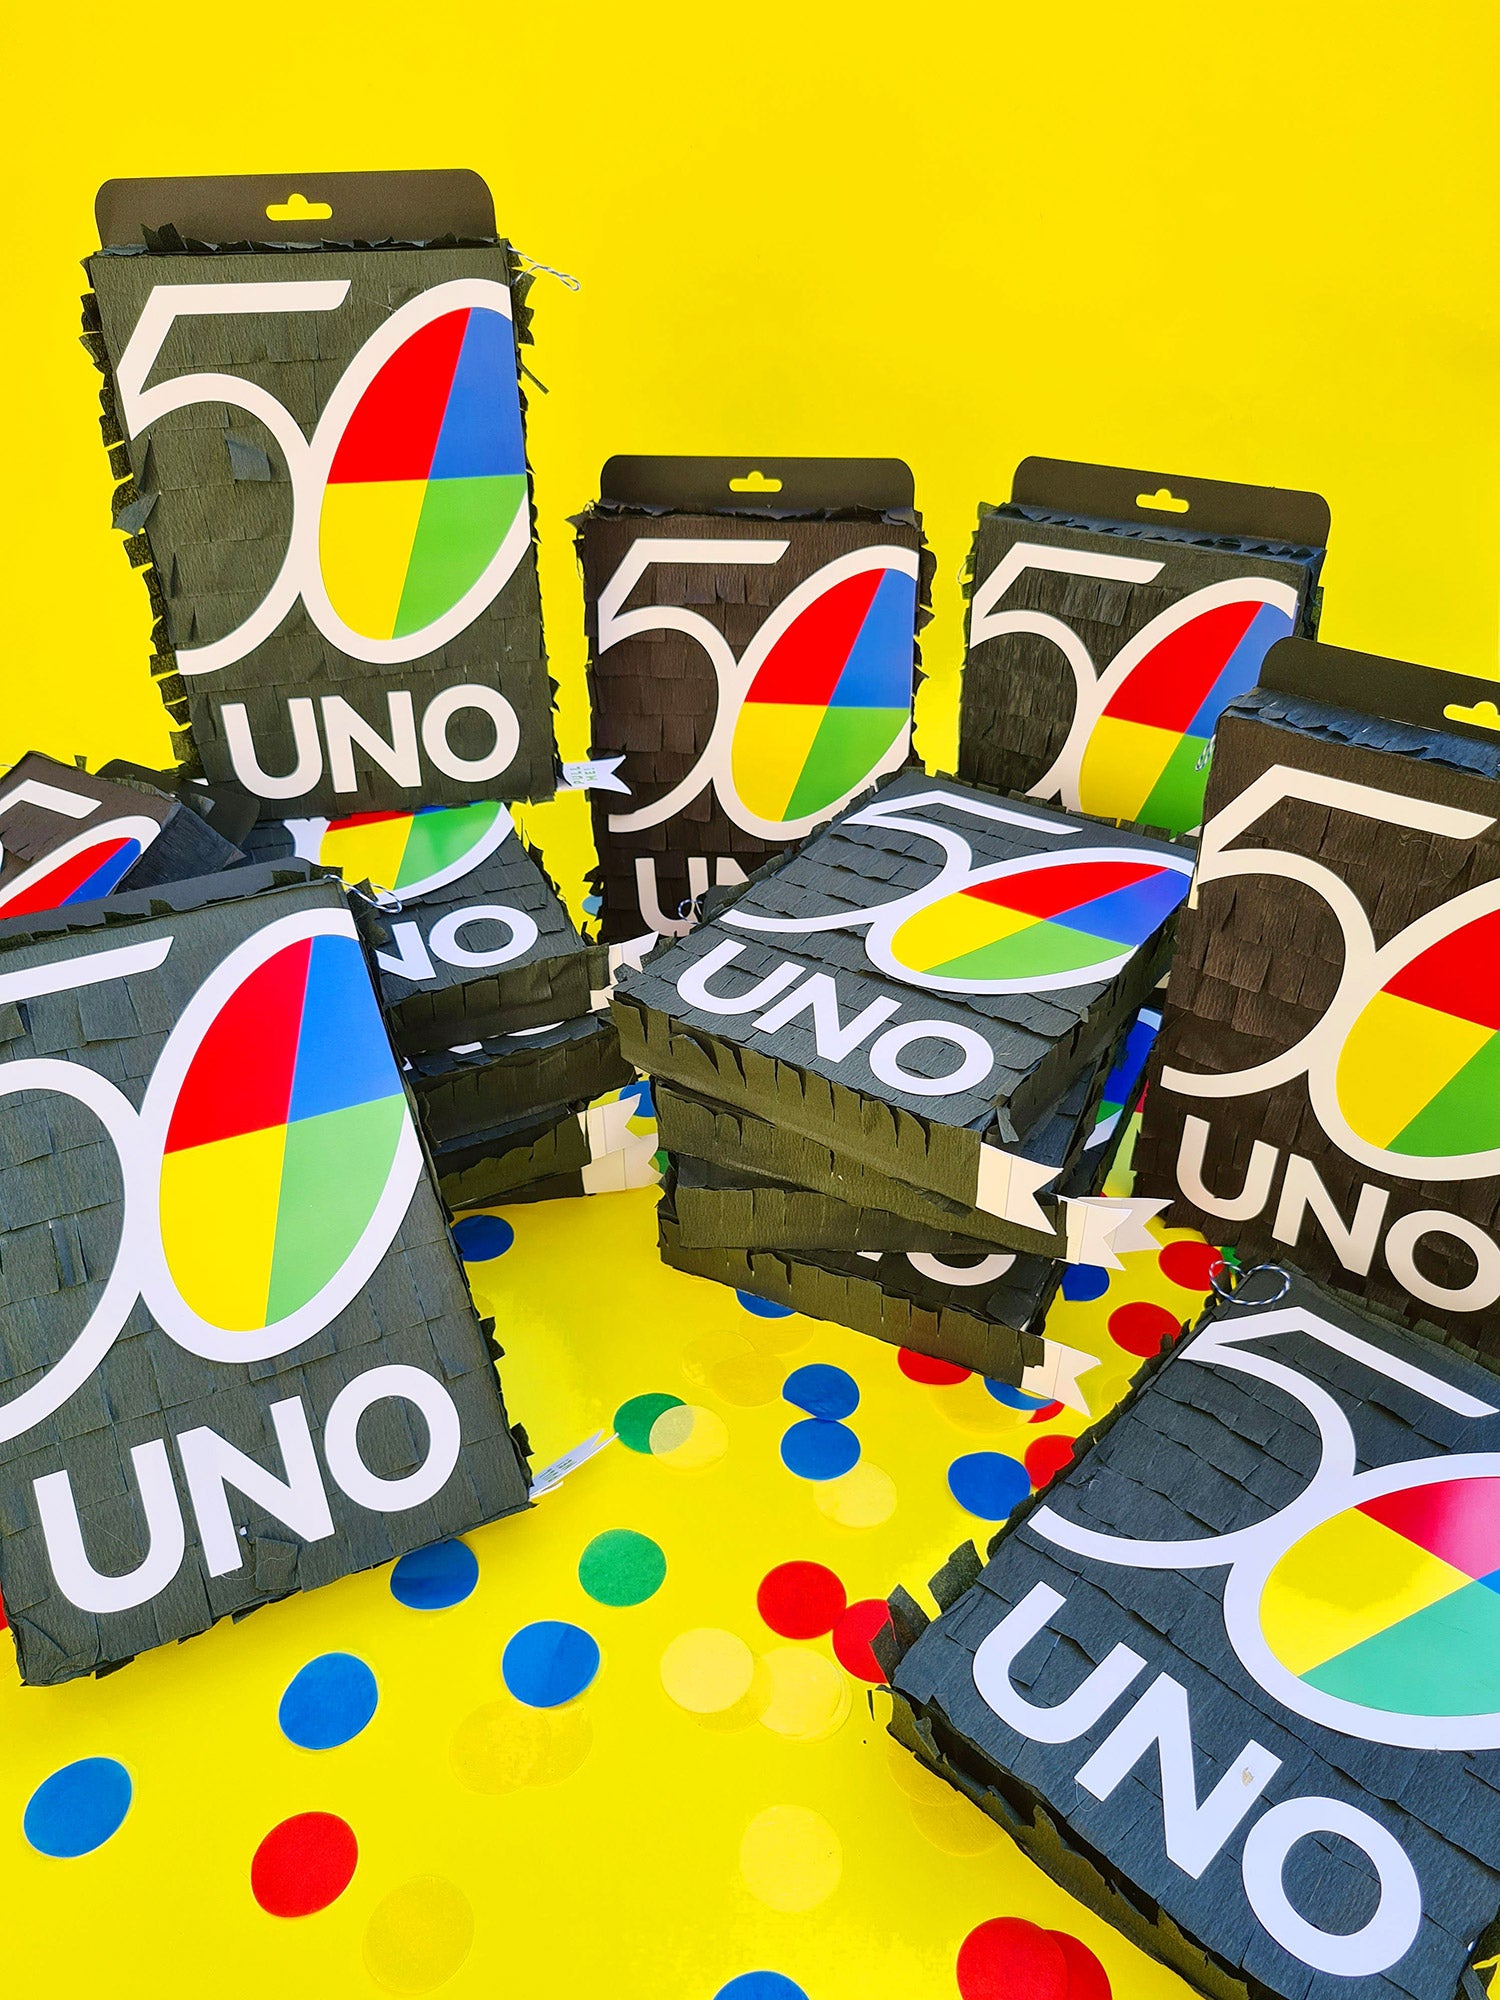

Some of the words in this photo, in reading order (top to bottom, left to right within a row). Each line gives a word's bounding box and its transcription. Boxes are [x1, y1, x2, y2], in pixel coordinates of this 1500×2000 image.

[116, 278, 533, 675] 50
[221, 684, 520, 800] UNO
[598, 537, 920, 841] 50
[970, 542, 1299, 842] 50
[375, 904, 538, 981] NO
[677, 939, 994, 1096] UNO
[720, 790, 1198, 994] 50
[1160, 764, 1500, 1181] 50
[1176, 1114, 1500, 1312] UNO
[33, 1364, 461, 1613] UNO
[1027, 1306, 1500, 1750] 50
[973, 1580, 1421, 1977] UNO
